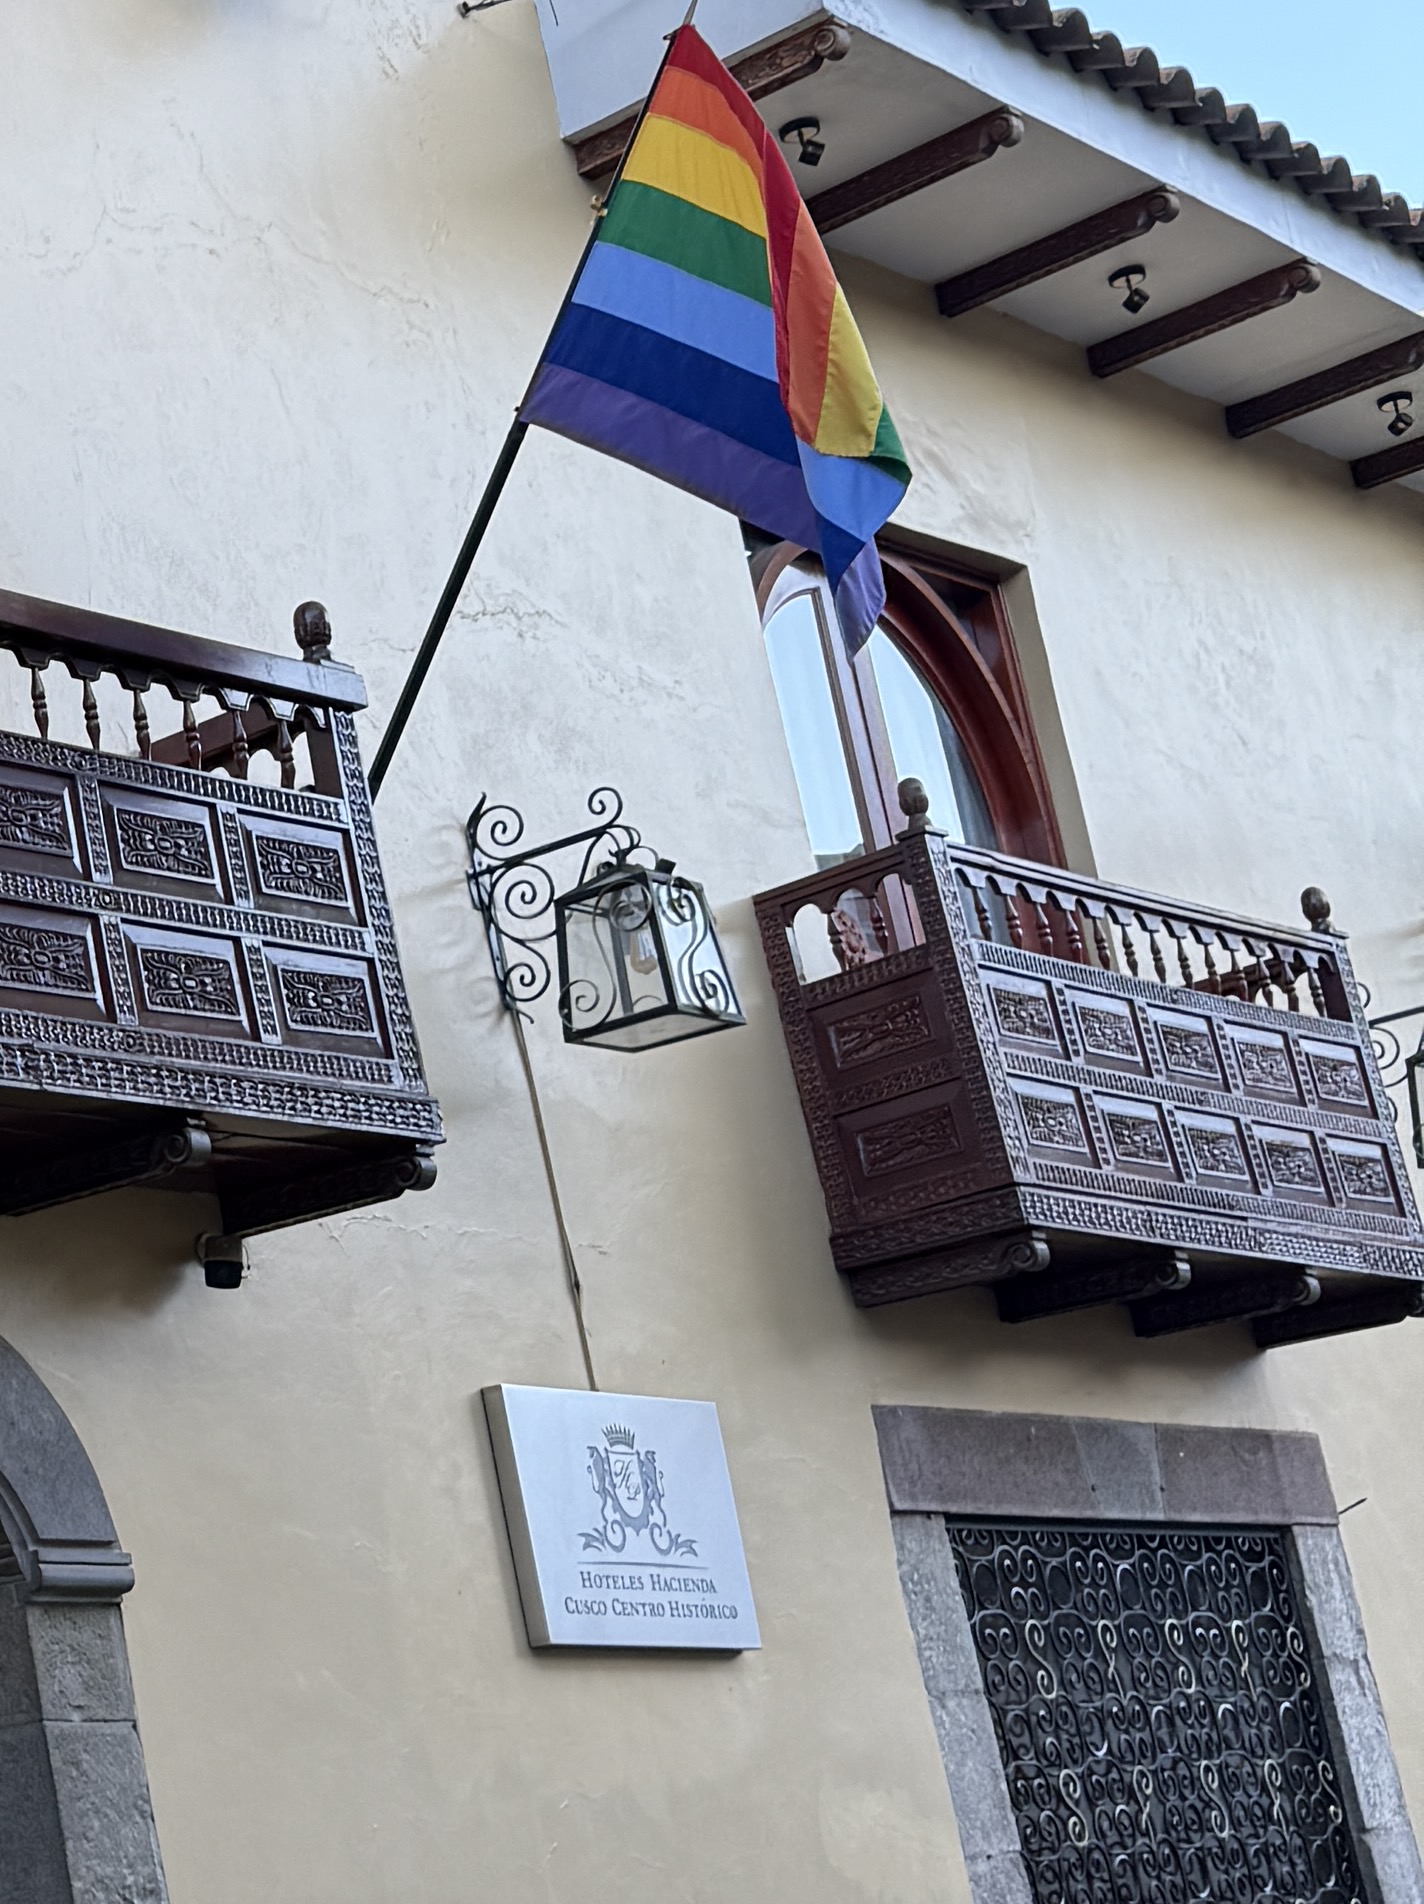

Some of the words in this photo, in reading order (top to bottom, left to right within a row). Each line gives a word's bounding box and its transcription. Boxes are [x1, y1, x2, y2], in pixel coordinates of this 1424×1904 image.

[580, 1570, 644, 1591] HOTELES
[649, 1573, 718, 1594] HACIENDA
[564, 1596, 608, 1616] CUSCO
[611, 1597, 665, 1619] CENTRO
[668, 1597, 738, 1620] HISTÓRICO
